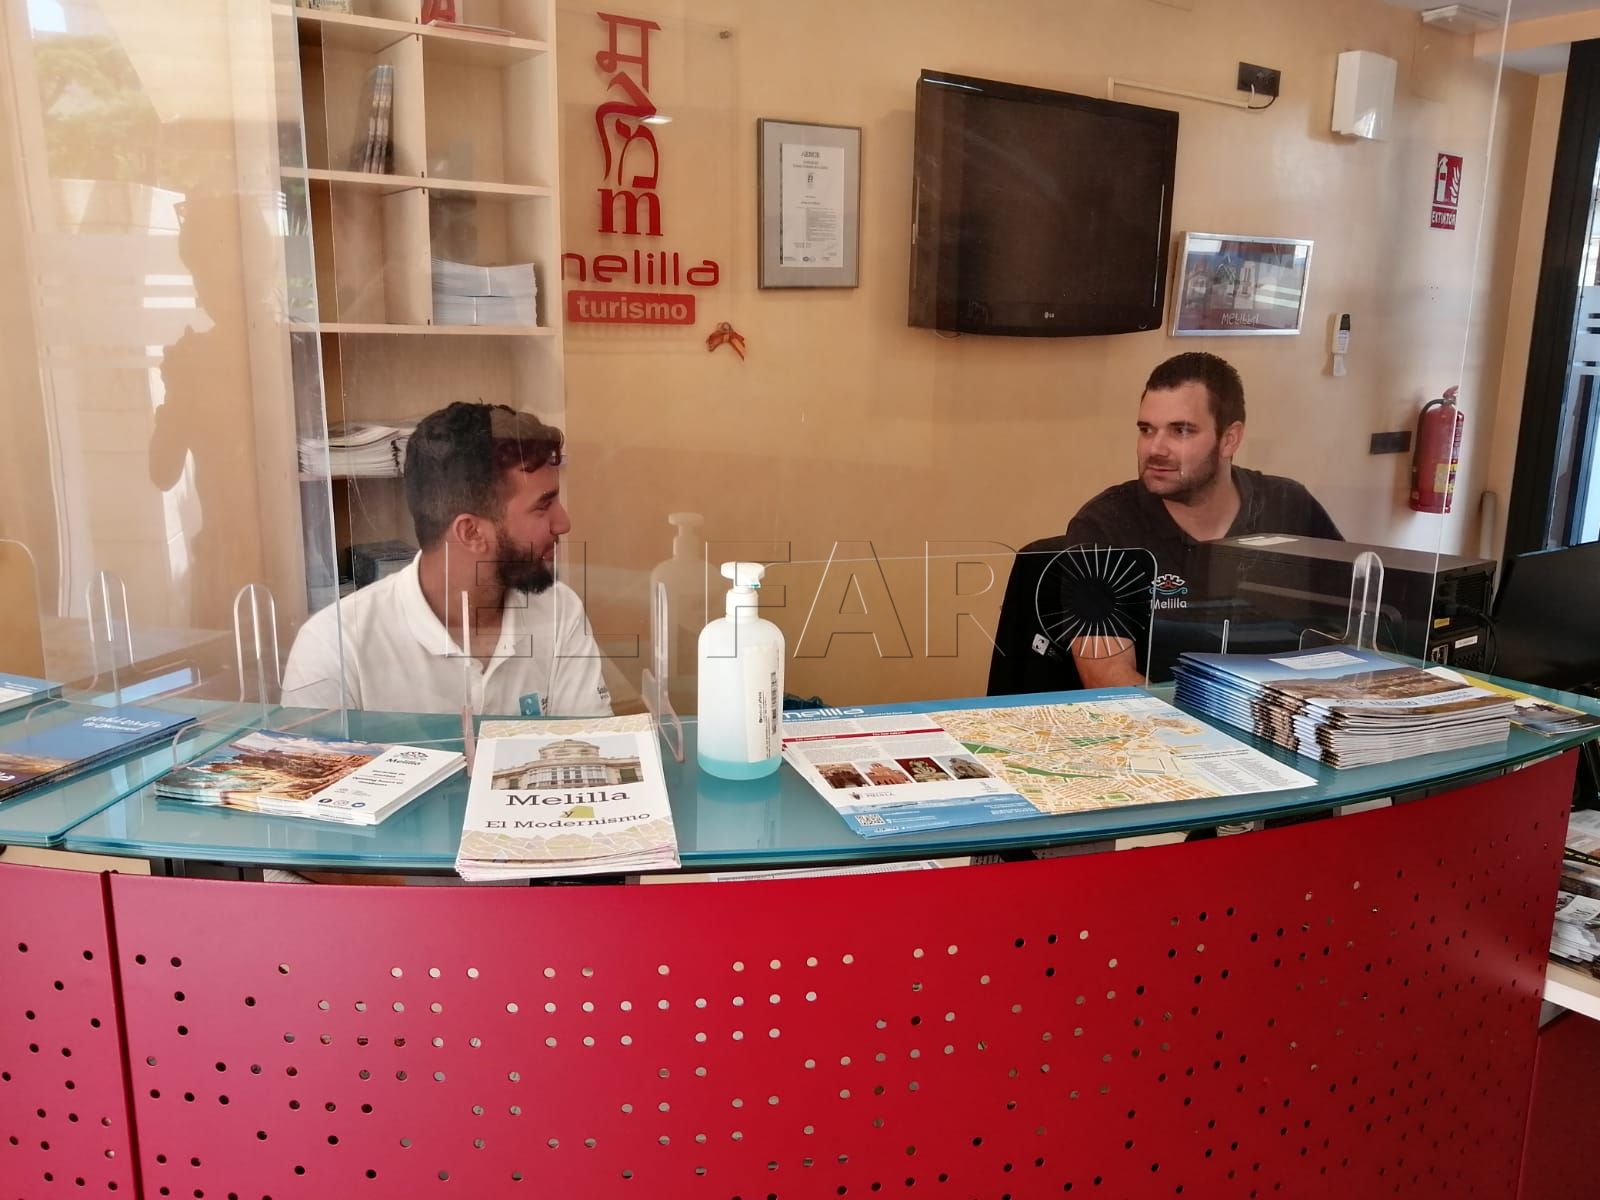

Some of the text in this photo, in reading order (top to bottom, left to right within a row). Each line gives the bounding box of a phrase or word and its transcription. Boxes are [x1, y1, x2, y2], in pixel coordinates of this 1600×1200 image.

[577, 296, 688, 320] turismo
[1150, 597, 1188, 610] Melilla
[506, 790, 631, 807] Melilla
[485, 812, 651, 829] El Modernismo
[564, 809, 574, 819] y
